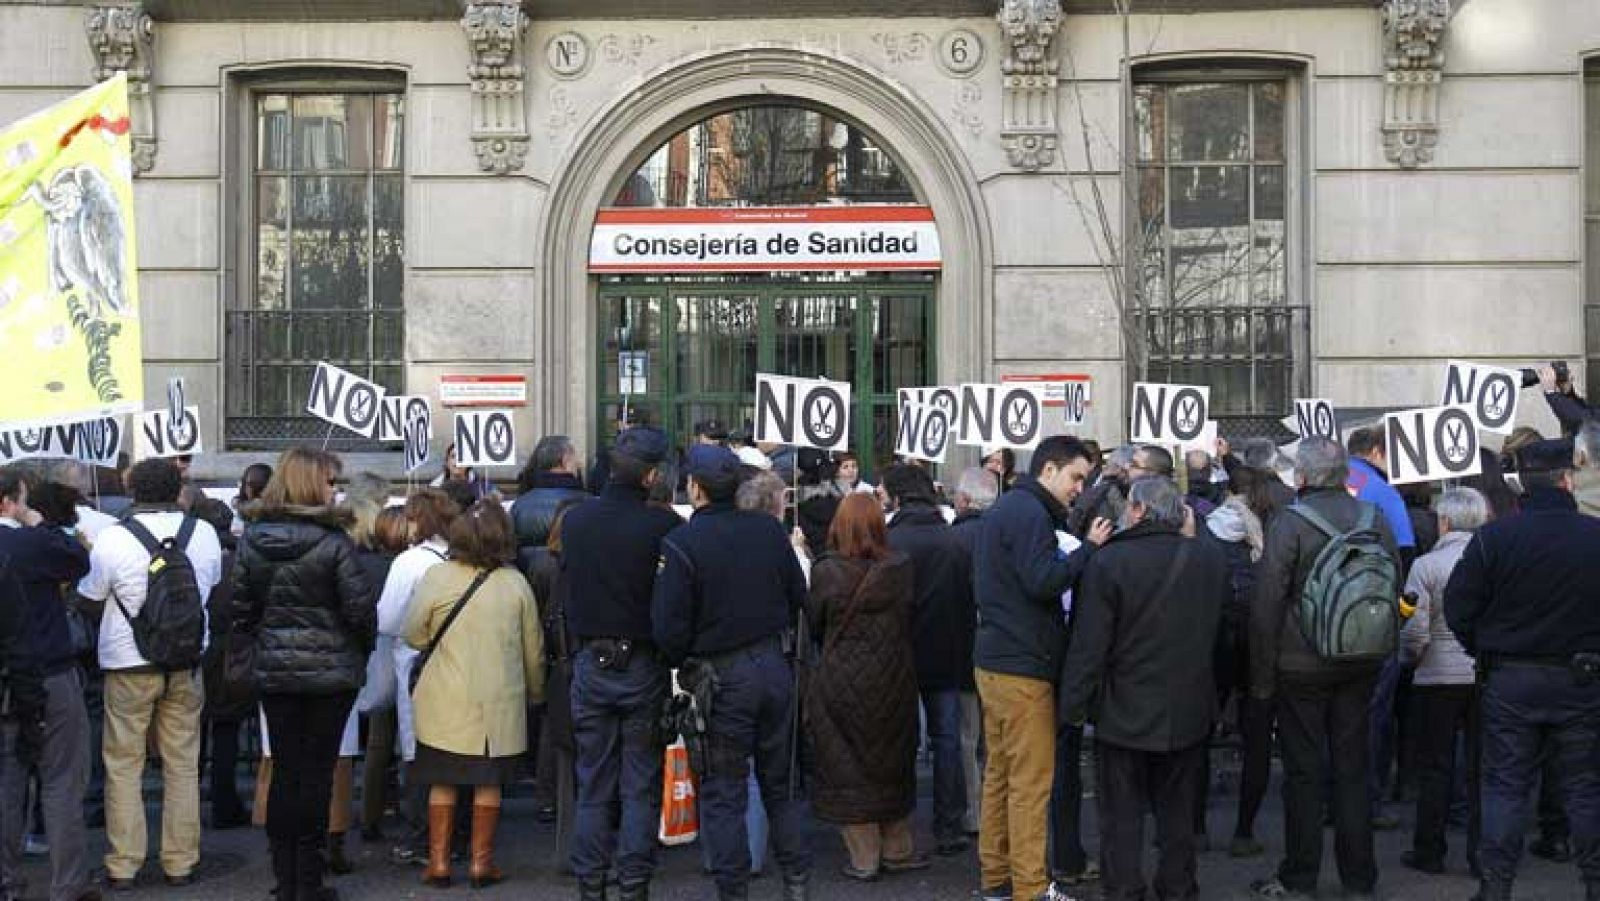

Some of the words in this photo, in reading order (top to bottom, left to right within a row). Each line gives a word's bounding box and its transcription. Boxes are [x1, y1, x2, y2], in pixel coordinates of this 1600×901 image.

[951, 38, 968, 63] 6
[613, 231, 757, 260] Consejería
[766, 232, 800, 255] de
[807, 230, 918, 255] Sanidad
[311, 366, 378, 429] NO
[757, 380, 845, 448] NO
[960, 386, 1039, 445] NO
[1133, 387, 1206, 441] NO
[1296, 401, 1333, 438] NO
[1444, 364, 1515, 429] NO
[404, 416, 428, 469] NO
[455, 413, 514, 462] NO
[898, 406, 948, 458] NO
[1389, 407, 1476, 479] NO
